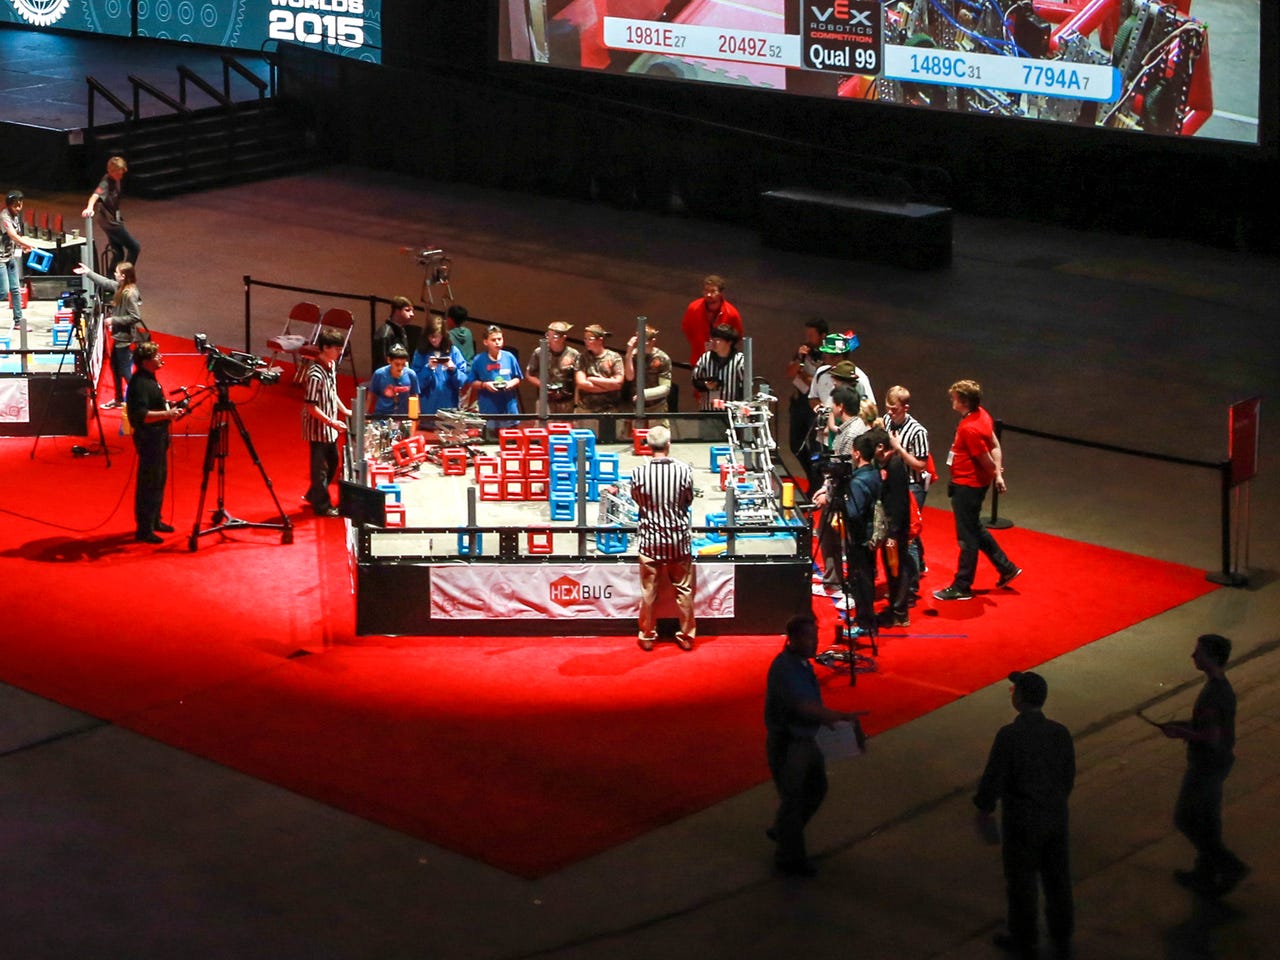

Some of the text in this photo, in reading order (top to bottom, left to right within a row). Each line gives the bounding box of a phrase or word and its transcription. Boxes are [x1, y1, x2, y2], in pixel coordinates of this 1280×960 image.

[810, 0, 873, 26] VEX
[268, 9, 364, 48] 2015
[810, 22, 873, 35] ROBOTICS
[810, 31, 873, 43] COMPETITION
[625, 25, 782, 58] 1981E 27 2049Z 52
[809, 44, 876, 69] Qual 99
[910, 53, 1090, 91] 1489C 31 7794A 7
[551, 584, 613, 600] HEXBUG
